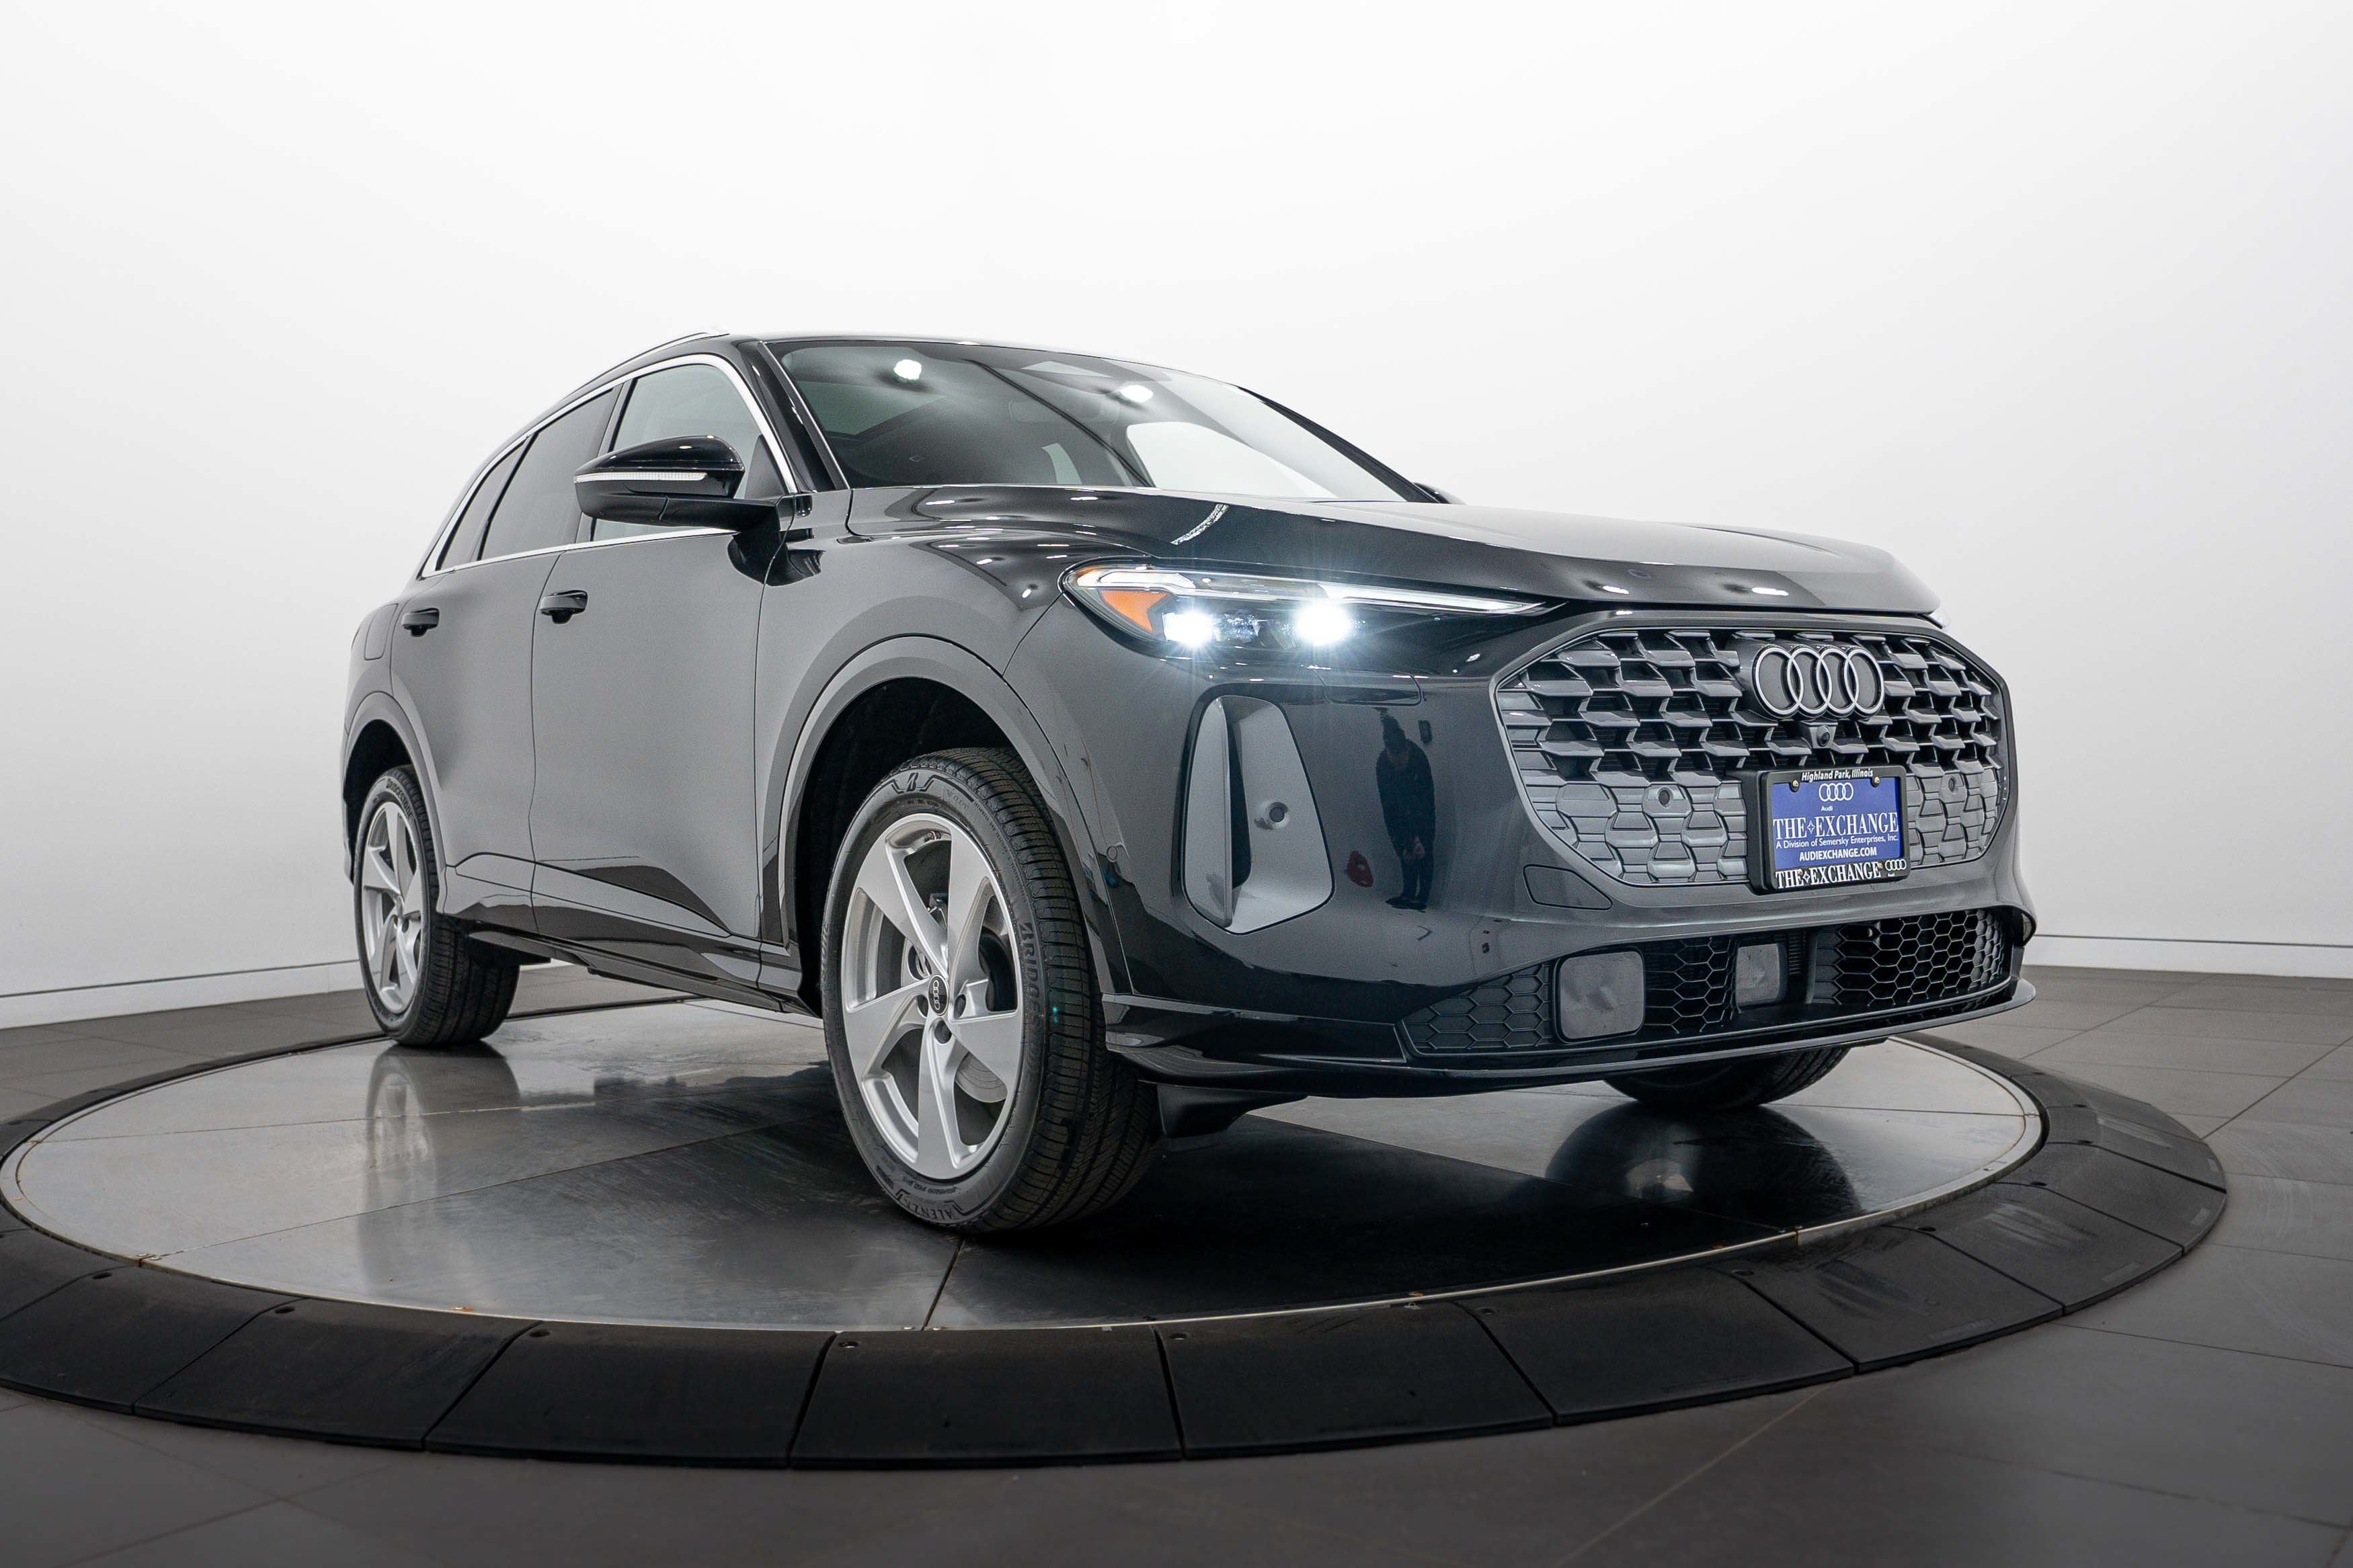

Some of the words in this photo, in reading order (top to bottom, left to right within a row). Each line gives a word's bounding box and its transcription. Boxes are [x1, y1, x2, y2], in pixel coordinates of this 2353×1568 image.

[1802, 770, 1833, 783] Highland
[1834, 769, 1851, 780] Park,
[1851, 768, 1874, 778] Illinois
[1773, 817, 1808, 840] THE
[1814, 812, 1899, 837] EXCHANGE
[1776, 841, 1782, 850] A
[1783, 840, 1809, 849] Division
[1810, 838, 1818, 847] of
[1819, 836, 1849, 848] Semersky
[1850, 835, 1886, 845] Enterprises,
[1887, 833, 1899, 841] Inc.
[1799, 846, 1877, 862] AUDIEXCHANGE.COM
[1775, 868, 1804, 889] THE
[1808, 861, 1881, 885] EXCHANGE
